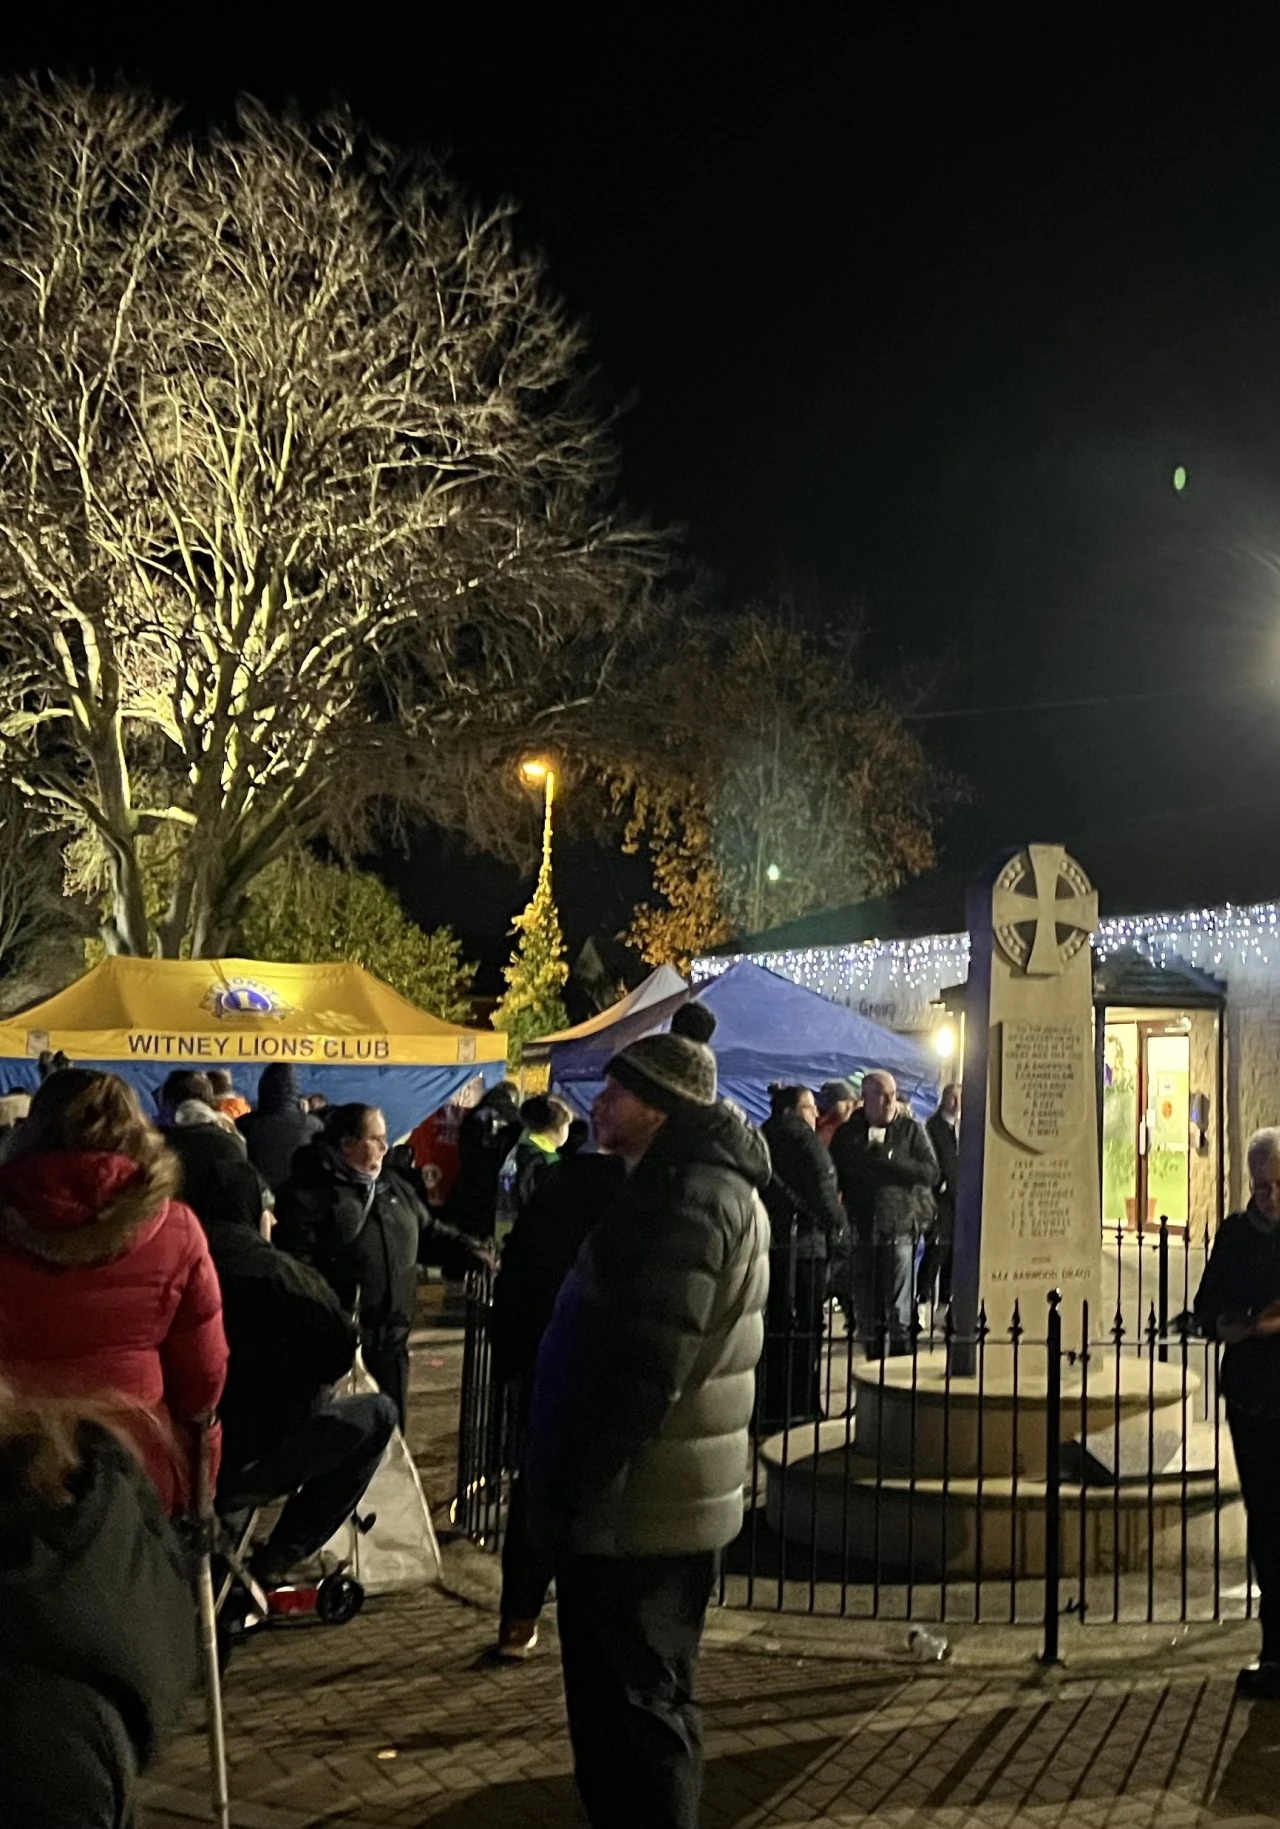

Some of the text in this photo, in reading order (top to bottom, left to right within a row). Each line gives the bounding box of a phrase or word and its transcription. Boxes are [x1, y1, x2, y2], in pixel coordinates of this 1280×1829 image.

[128, 1034, 390, 1059] WITNEY LIONS CLUB
